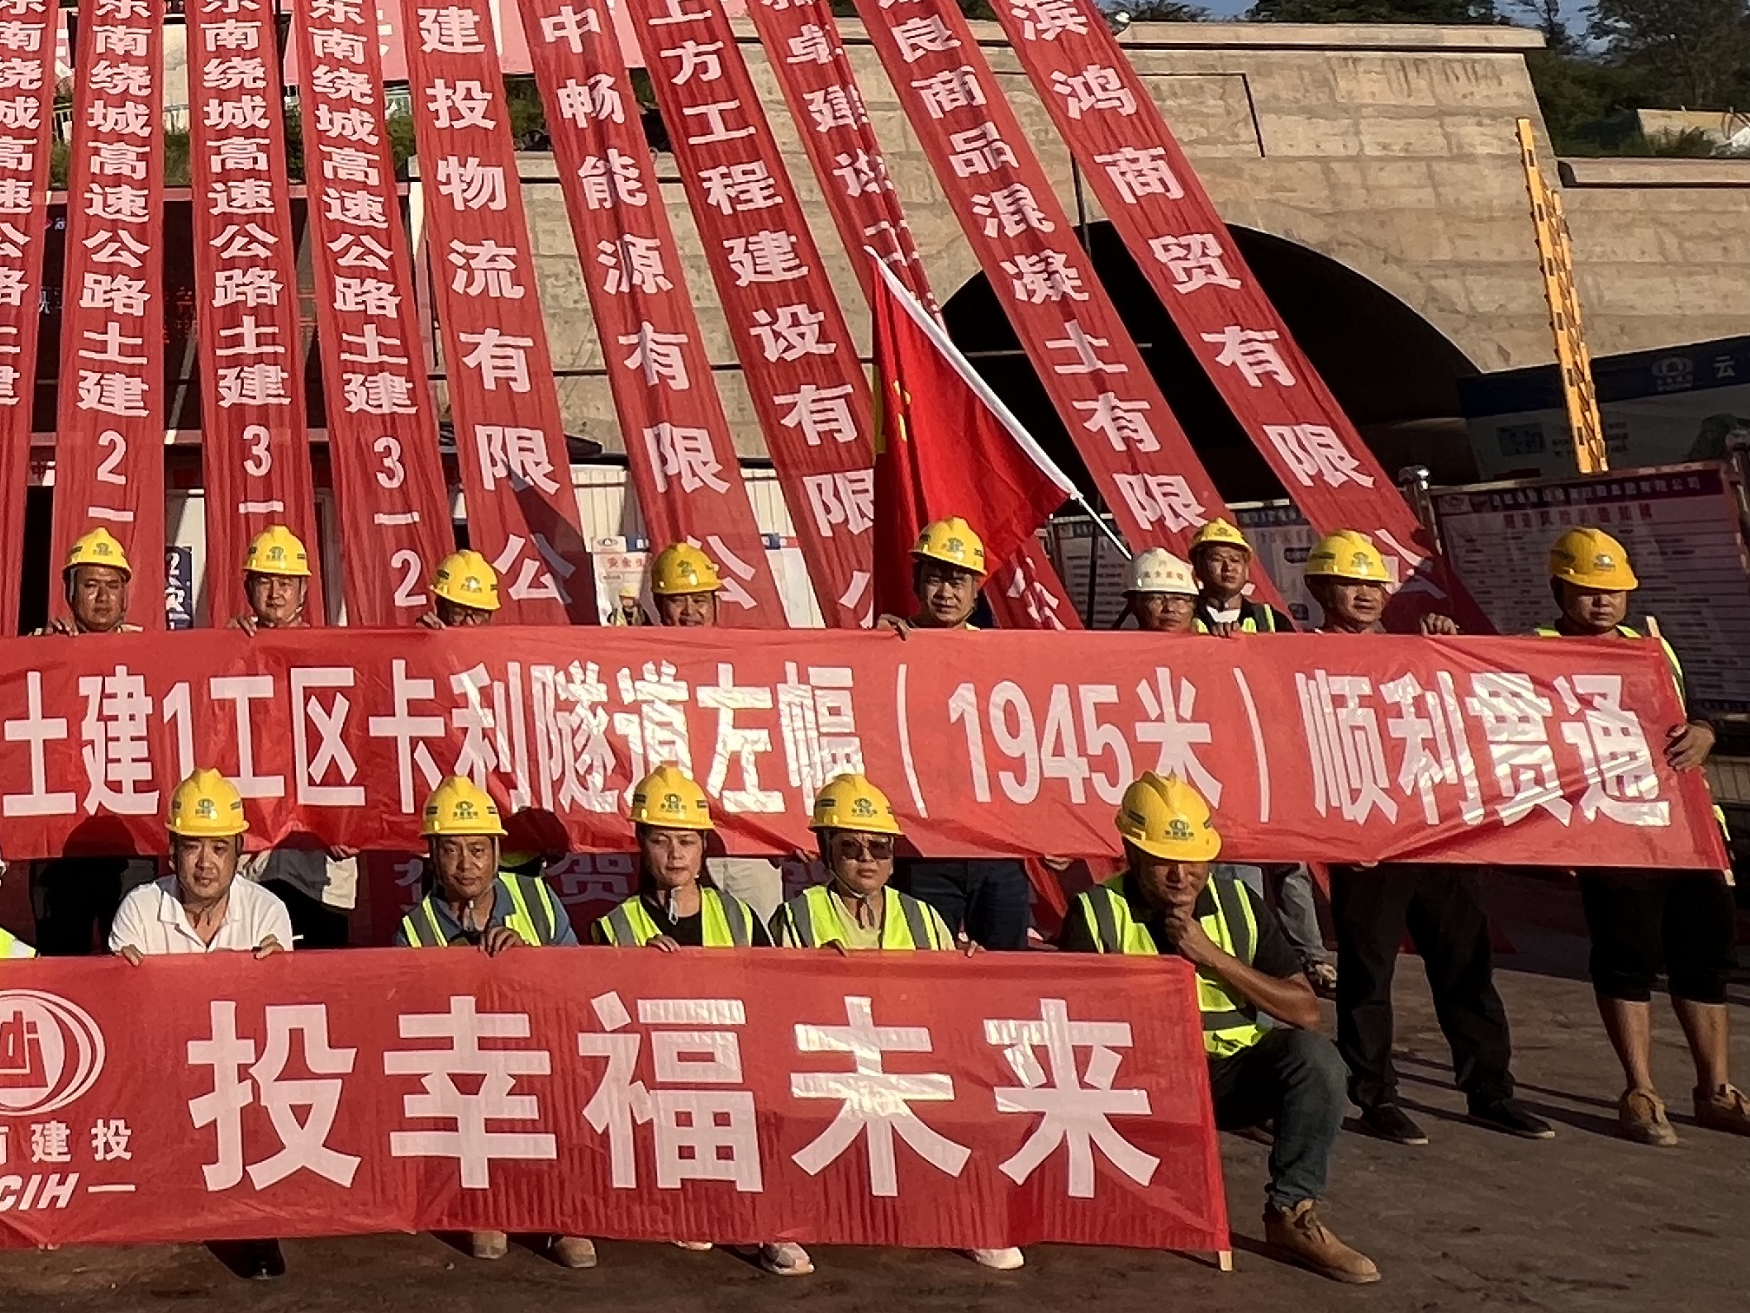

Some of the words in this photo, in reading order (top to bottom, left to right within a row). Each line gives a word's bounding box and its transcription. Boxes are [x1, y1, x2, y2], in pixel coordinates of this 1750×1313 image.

[186, 991, 1161, 1199] 投幸福未来
